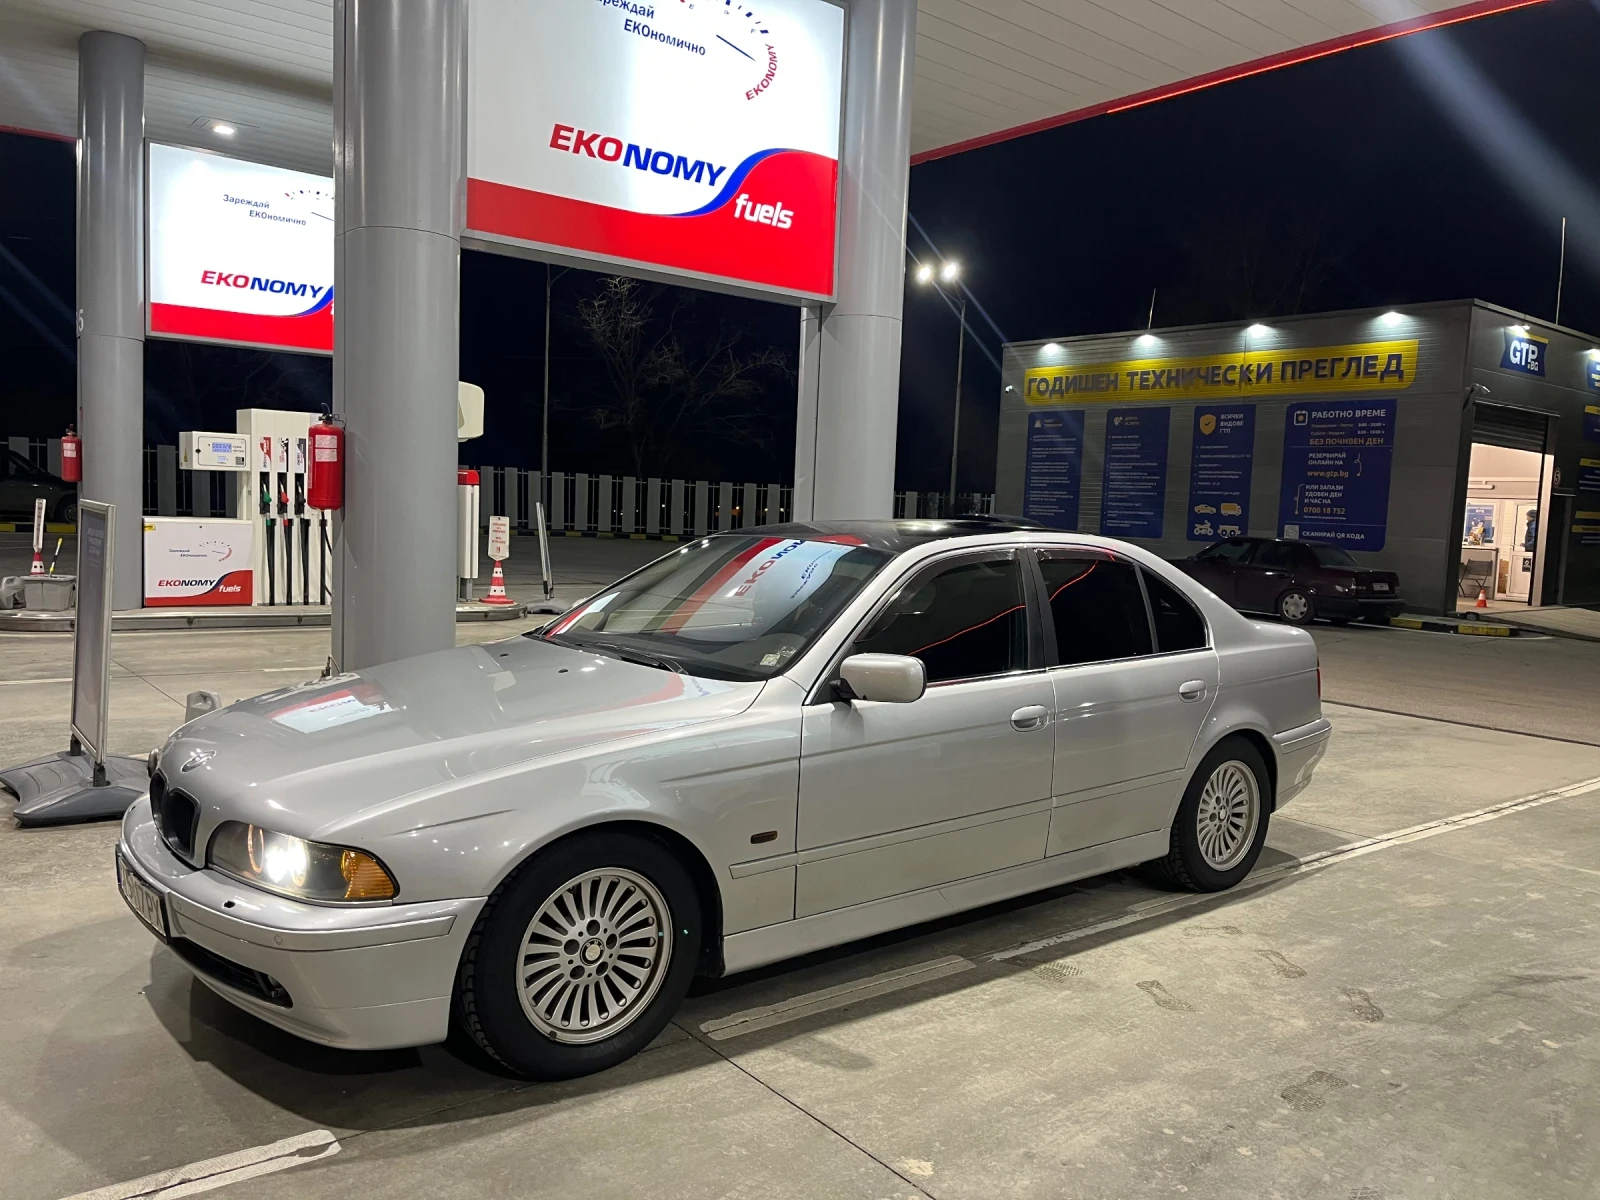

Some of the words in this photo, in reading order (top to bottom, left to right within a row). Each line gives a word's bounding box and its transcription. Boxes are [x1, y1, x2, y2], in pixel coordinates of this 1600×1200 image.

[596, 0, 654, 19] реждай
[623, 18, 706, 56] ЕКОномично
[745, 43, 778, 101] EKONOMY
[549, 123, 727, 187] EKONOMY
[222, 194, 270, 209] Зареждай
[248, 209, 307, 226] ЕКОномично
[733, 193, 794, 229] fuels
[200, 270, 324, 299] EKONOMY
[1509, 339, 1538, 366] GTP
[1027, 372, 1119, 400] ГОДИШЕН
[1126, 362, 1273, 391] ТЕХНИЧЕСКИ
[1280, 353, 1404, 383] ПРЕГЛЕД
[1311, 410, 1353, 419] РАБОТНО
[1355, 409, 1386, 418] ВРЕМЕ
[1325, 437, 1364, 445] ПОЧИВЕН
[1366, 437, 1384, 446] ДЕН
[1307, 470, 1349, 478] www.gtp.bg
[1302, 530, 1335, 538] СКАНИРАЙ
[158, 579, 216, 587] EKONOMY
[218, 584, 241, 593] fuels
